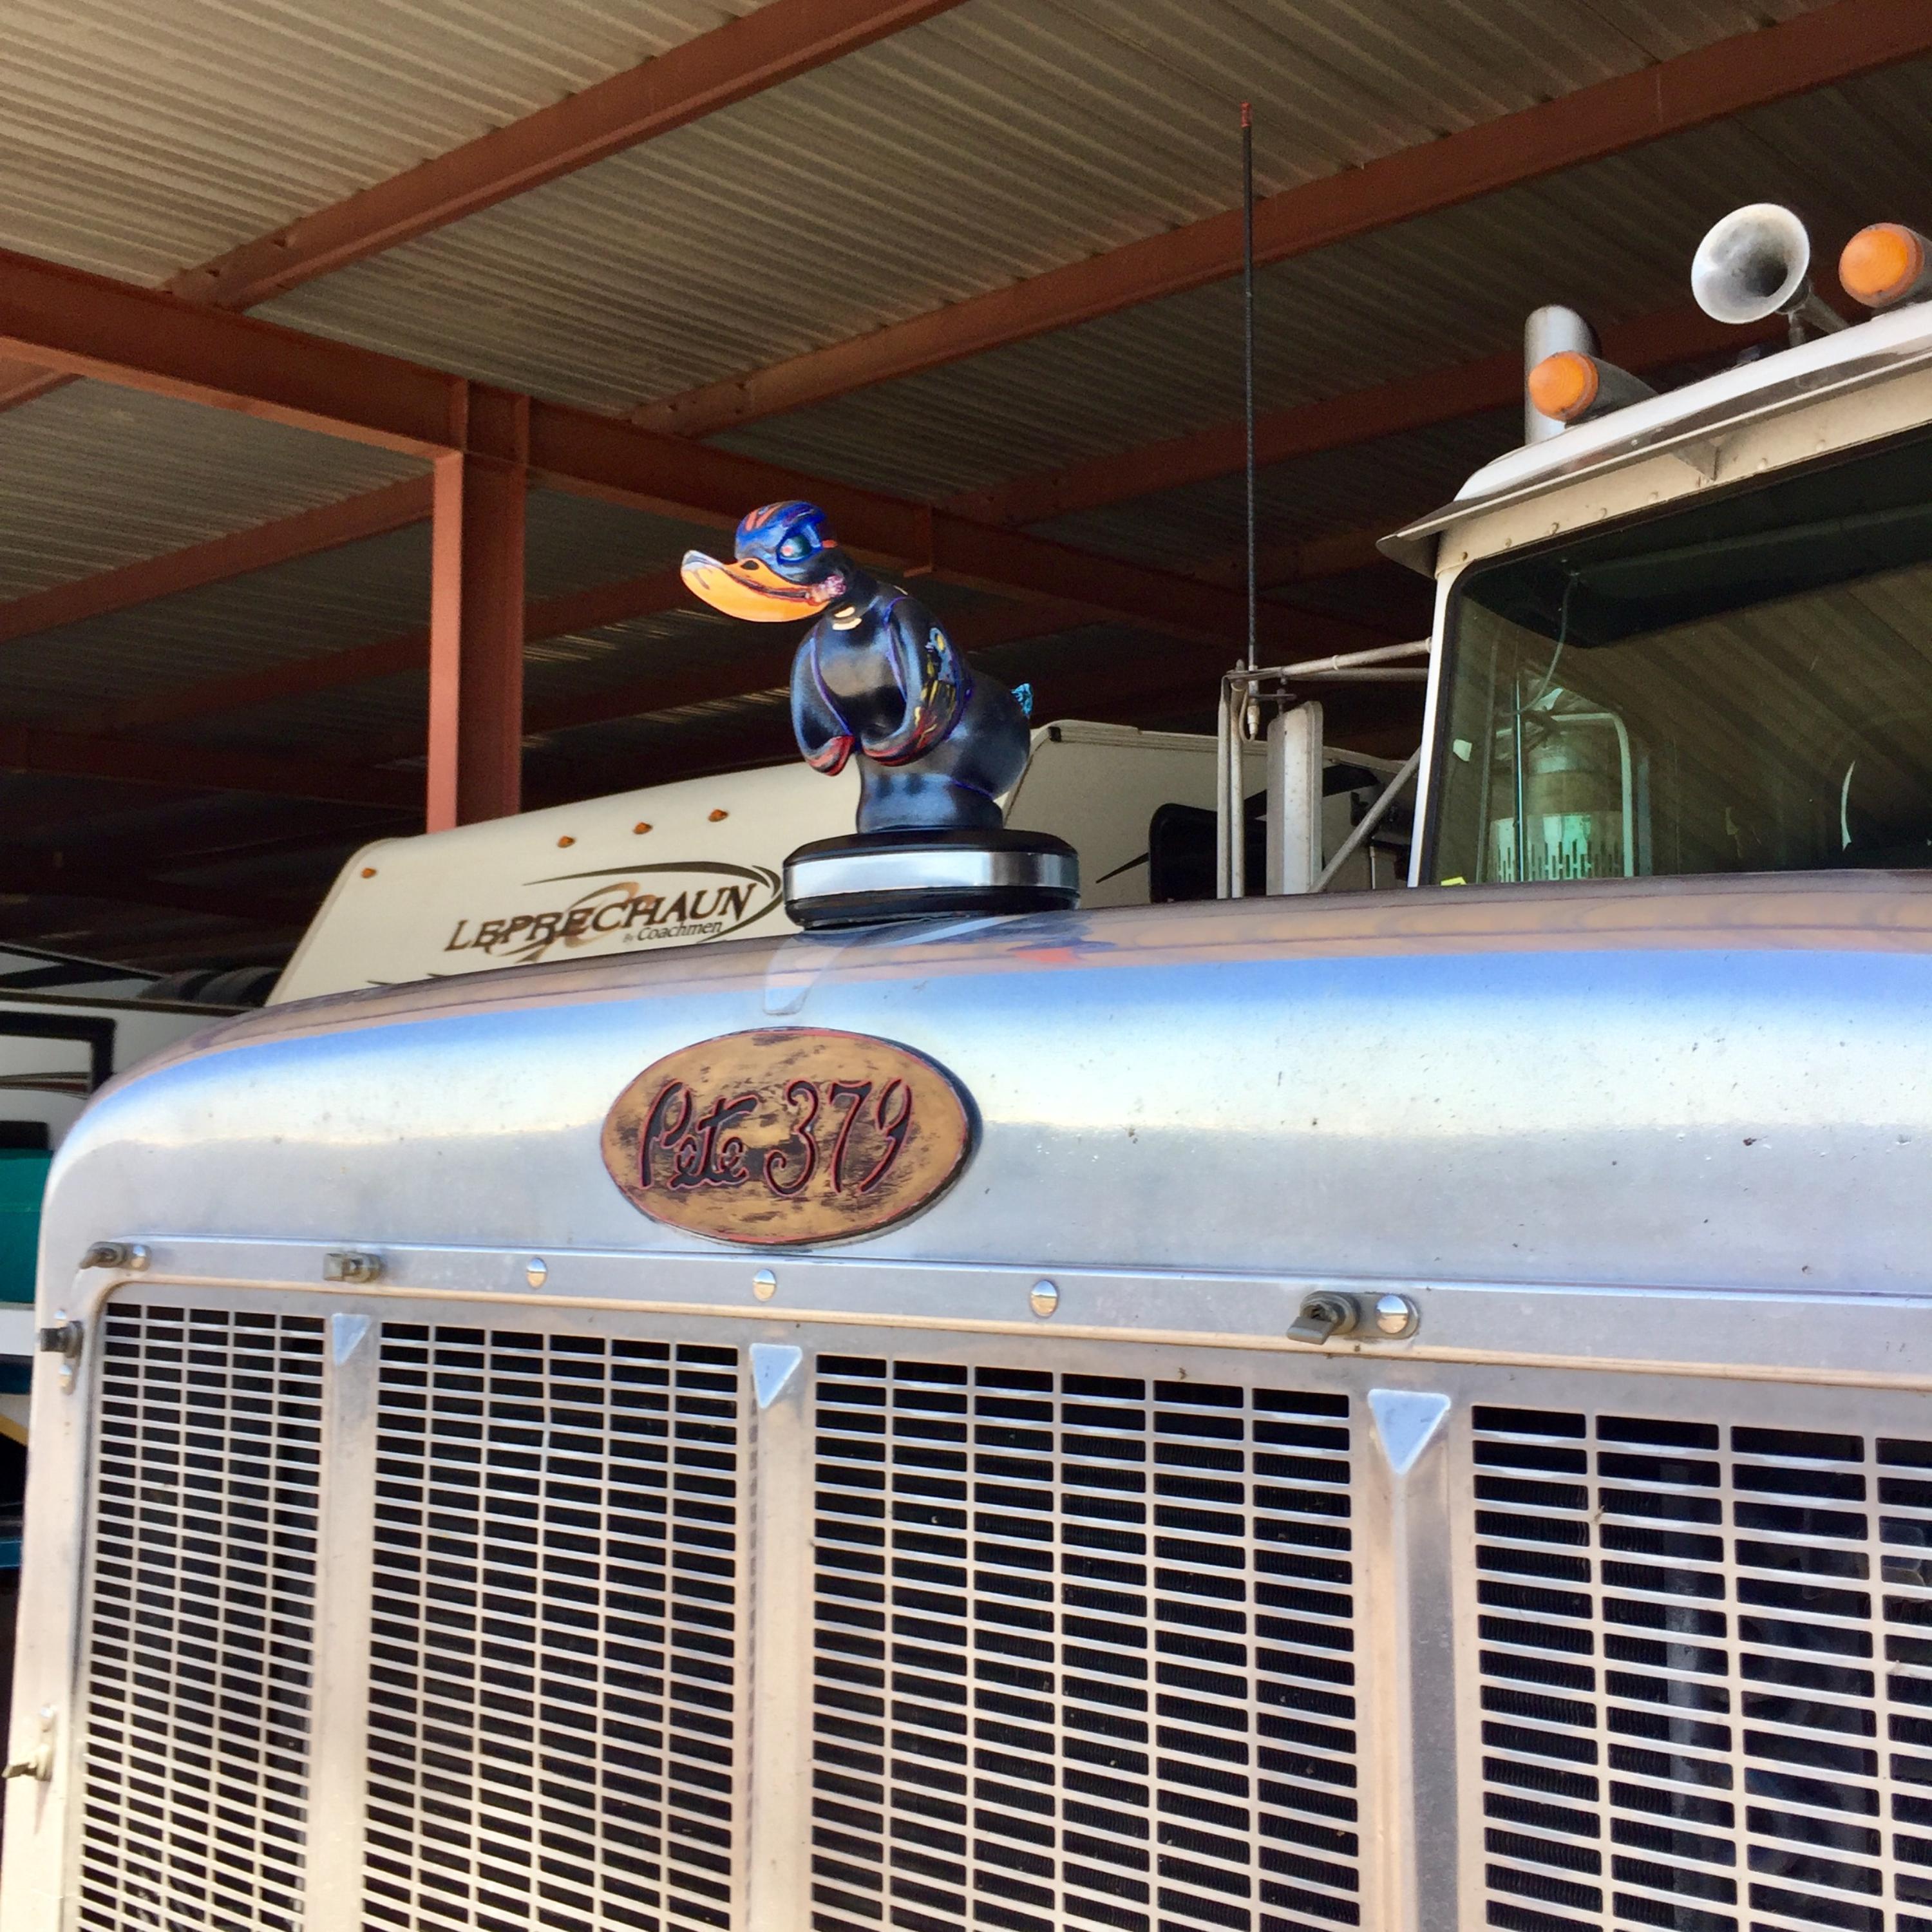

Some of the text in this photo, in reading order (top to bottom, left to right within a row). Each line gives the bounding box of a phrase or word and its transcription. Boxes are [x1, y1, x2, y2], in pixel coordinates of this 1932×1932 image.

[444, 883, 757, 953] LEPRECHAUN
[637, 921, 723, 942] Coachmen
[639, 1077, 913, 1197] Pete 379
